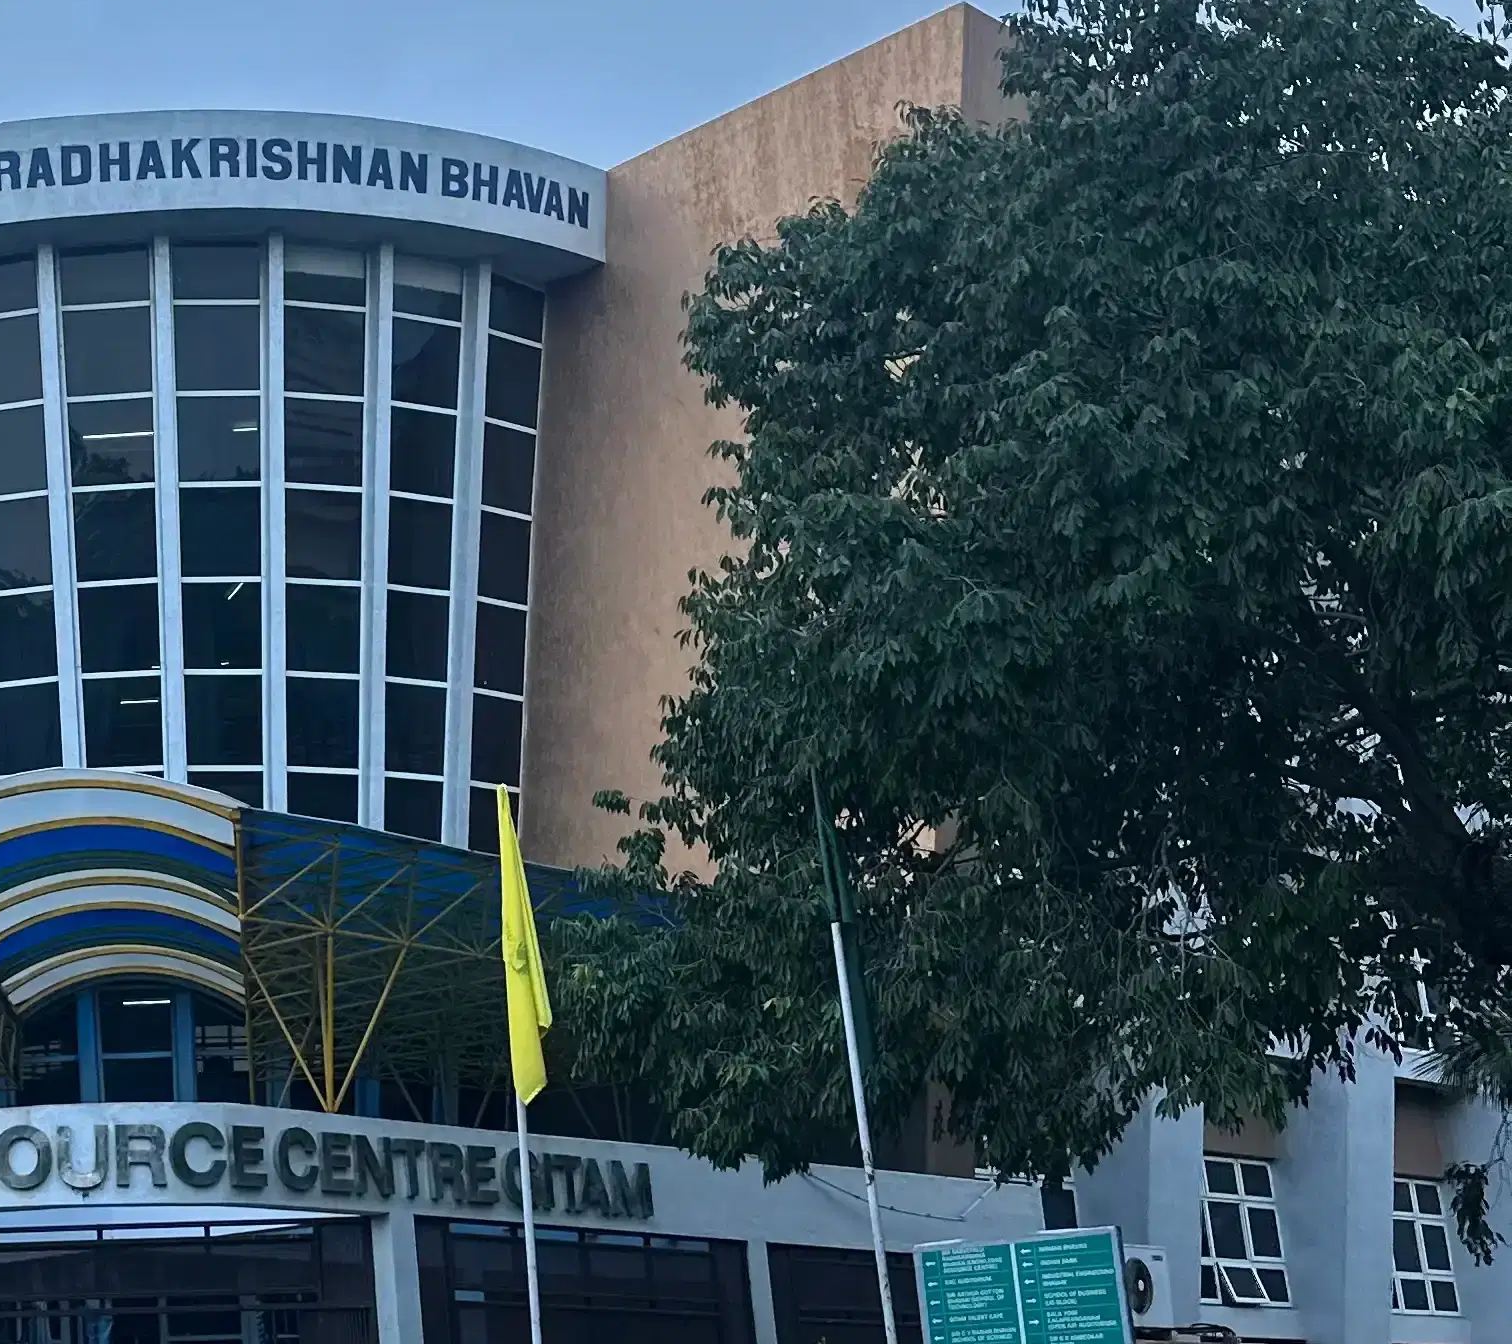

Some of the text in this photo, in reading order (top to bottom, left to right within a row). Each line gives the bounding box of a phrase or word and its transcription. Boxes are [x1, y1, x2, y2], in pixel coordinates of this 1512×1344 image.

[441, 158, 590, 230] BHAVAN
[273, 1126, 500, 1206] CENTRE
[501, 1147, 655, 1220] GITAM
